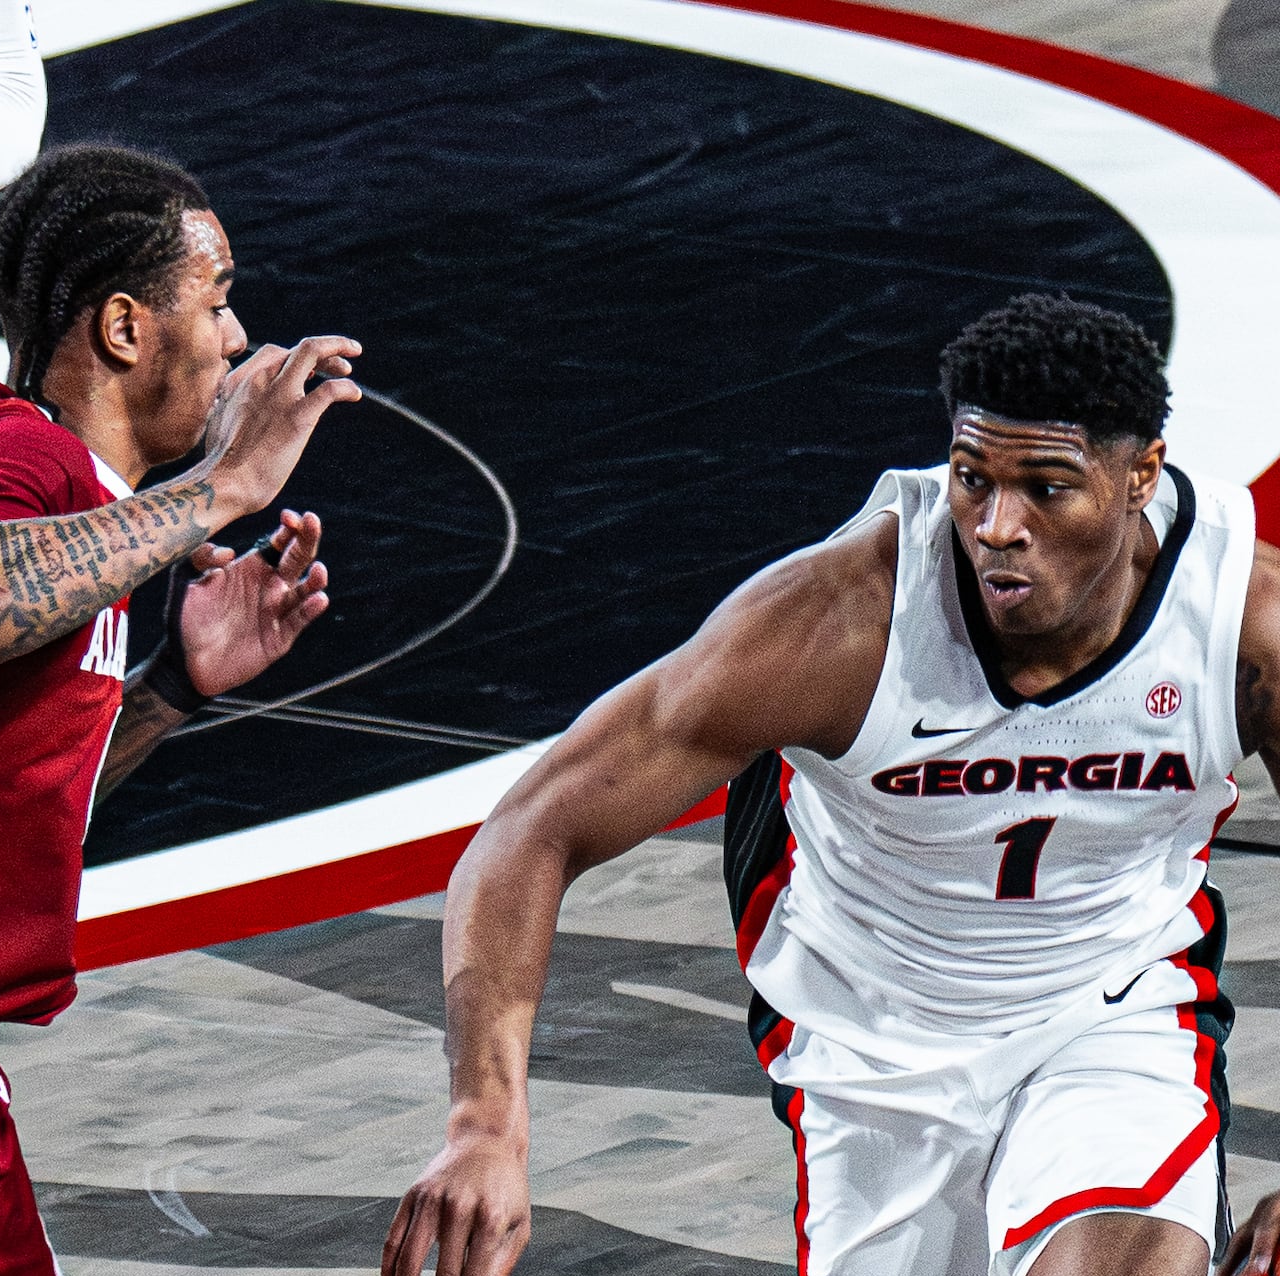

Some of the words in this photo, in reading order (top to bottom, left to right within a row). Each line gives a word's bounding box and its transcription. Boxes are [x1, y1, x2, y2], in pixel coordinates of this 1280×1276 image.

[1149, 684, 1179, 716] SEC
[871, 752, 1196, 797] GEORGIA
[994, 815, 1057, 900] 1
